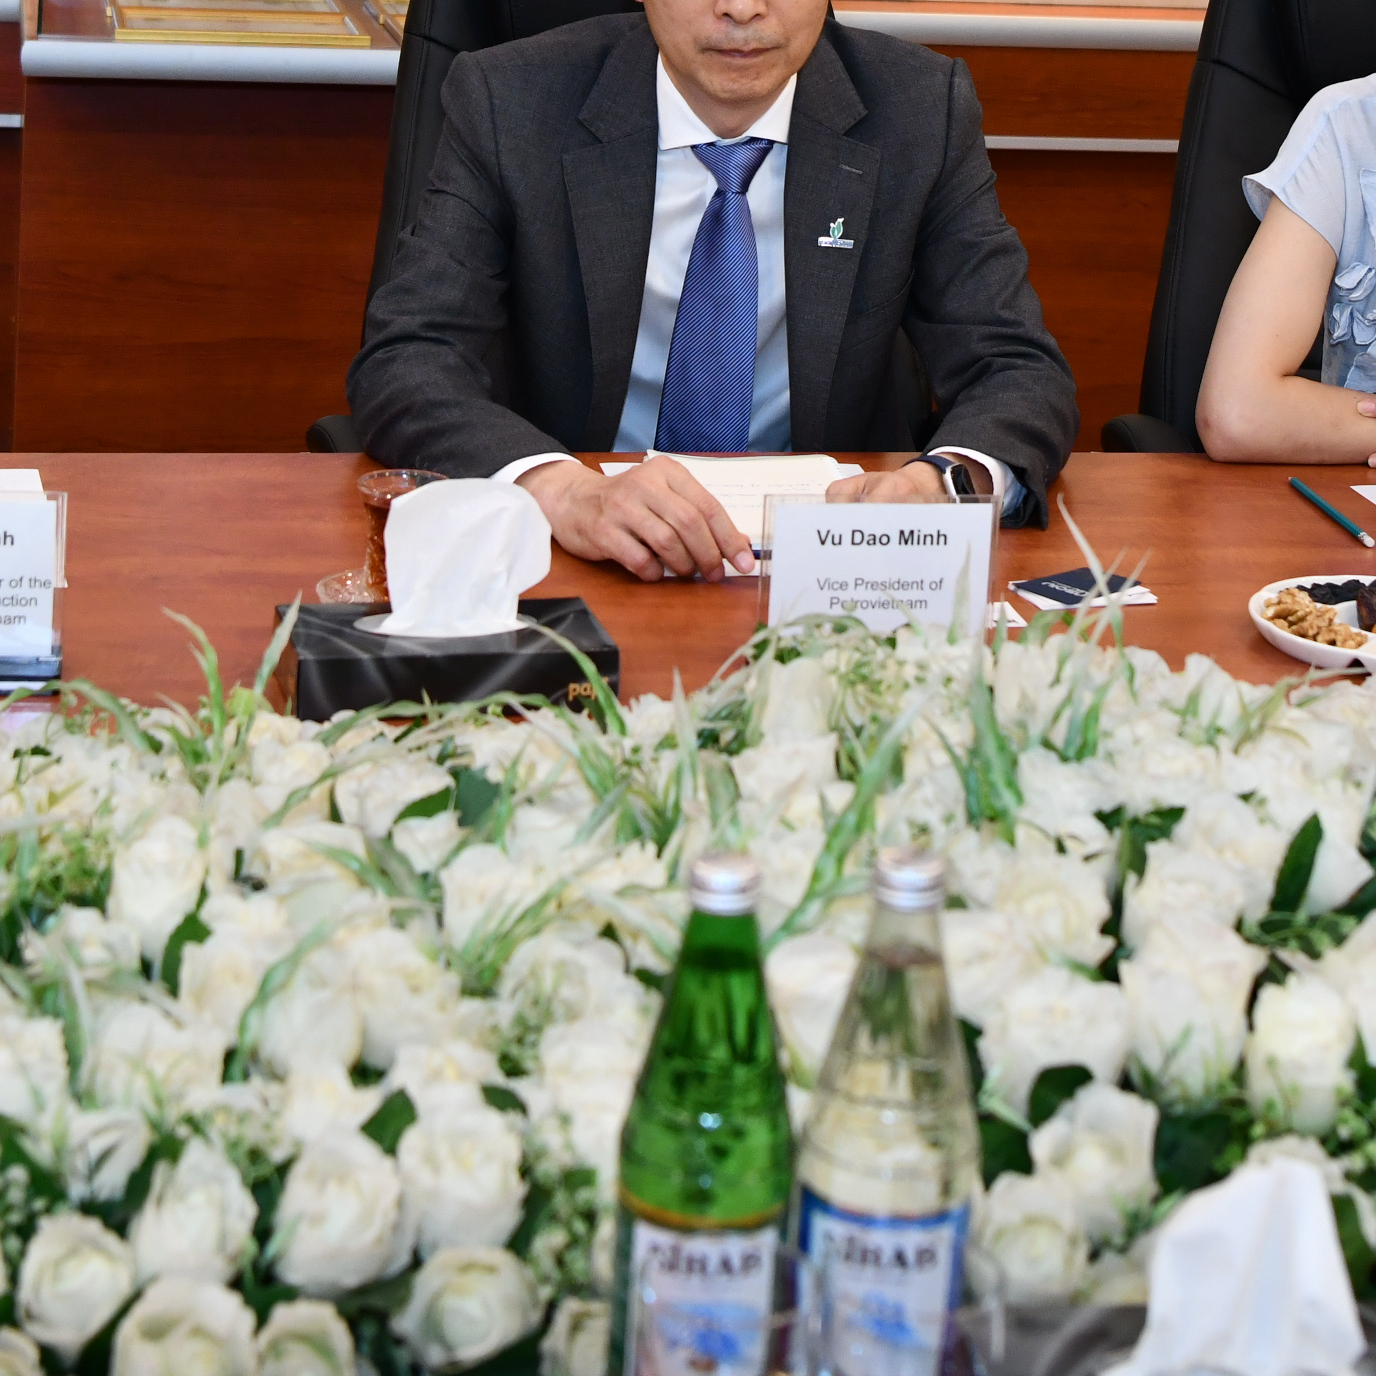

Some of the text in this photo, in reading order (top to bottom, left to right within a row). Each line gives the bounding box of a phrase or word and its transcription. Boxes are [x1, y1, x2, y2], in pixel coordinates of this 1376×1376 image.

[816, 529, 948, 546] Vu Dao Minh
[9, 576, 24, 589] of
[28, 576, 52, 589] the
[816, 577, 944, 591] Vice President of
